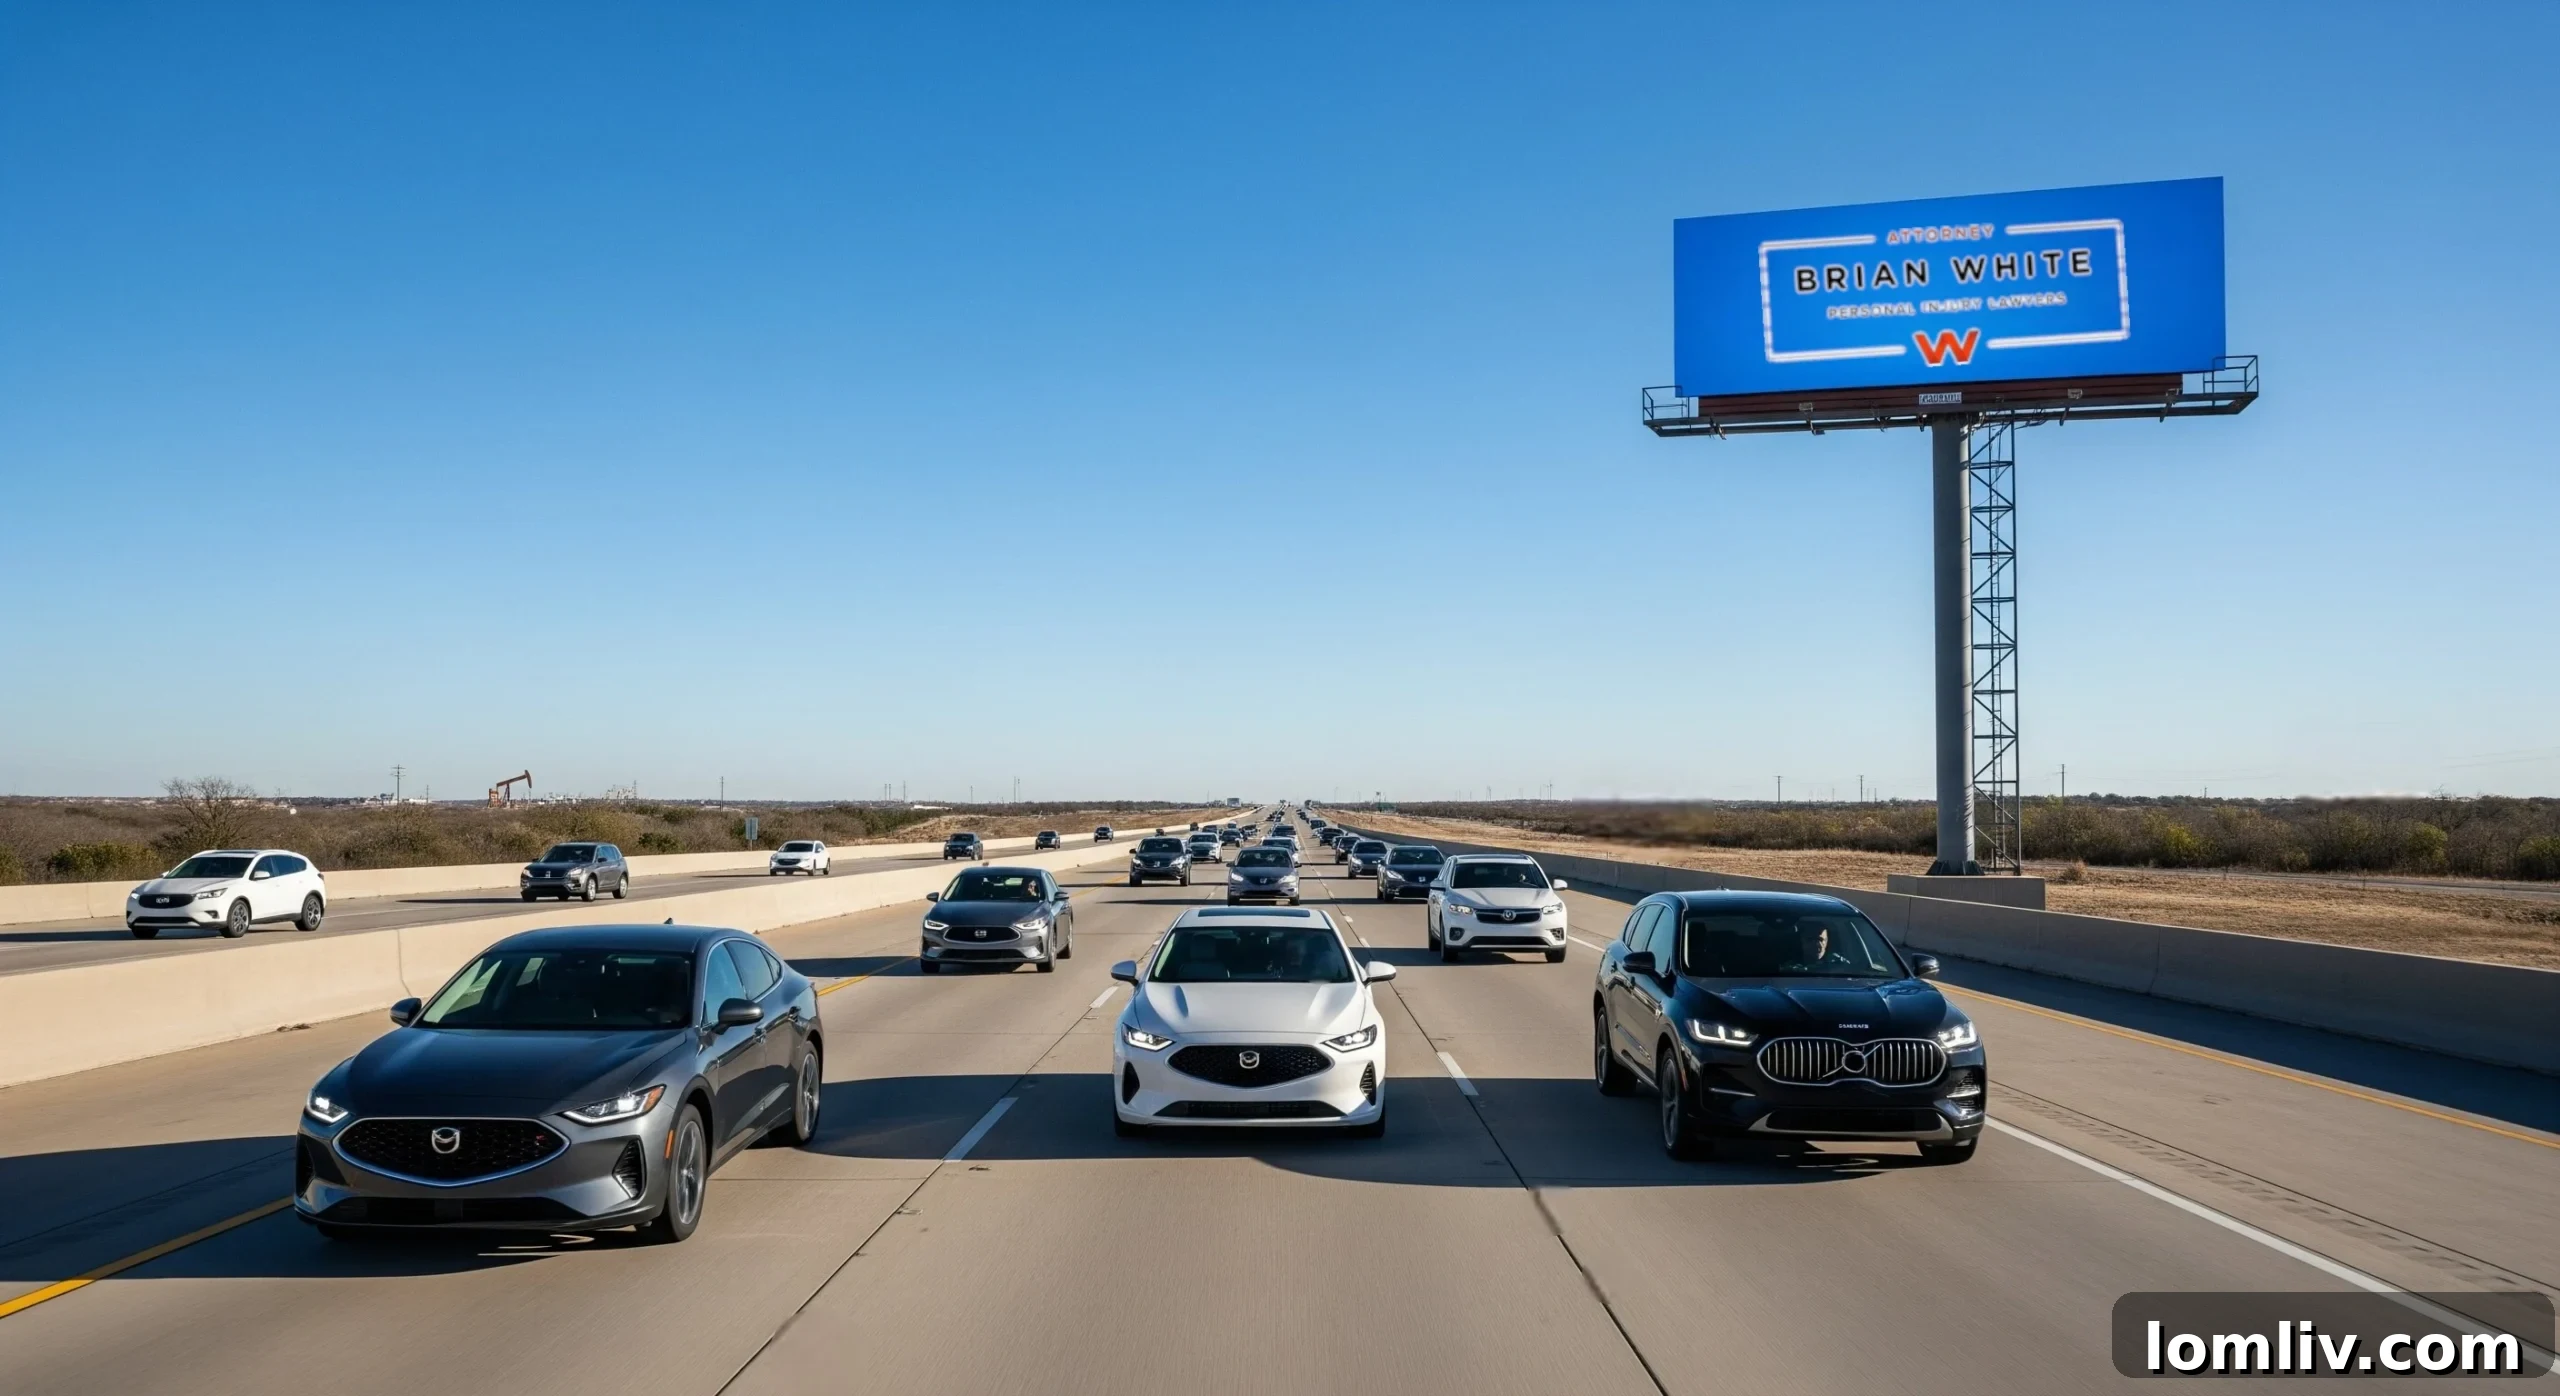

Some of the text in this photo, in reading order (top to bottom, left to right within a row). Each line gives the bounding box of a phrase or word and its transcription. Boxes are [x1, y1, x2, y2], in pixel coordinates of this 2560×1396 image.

[1887, 225, 1995, 244] ATTORNEY
[1796, 250, 2091, 292] BRIAN WHITE
[1827, 292, 2067, 319] PERSONAL INJURY LAWYERS
[1914, 328, 1980, 366] W
